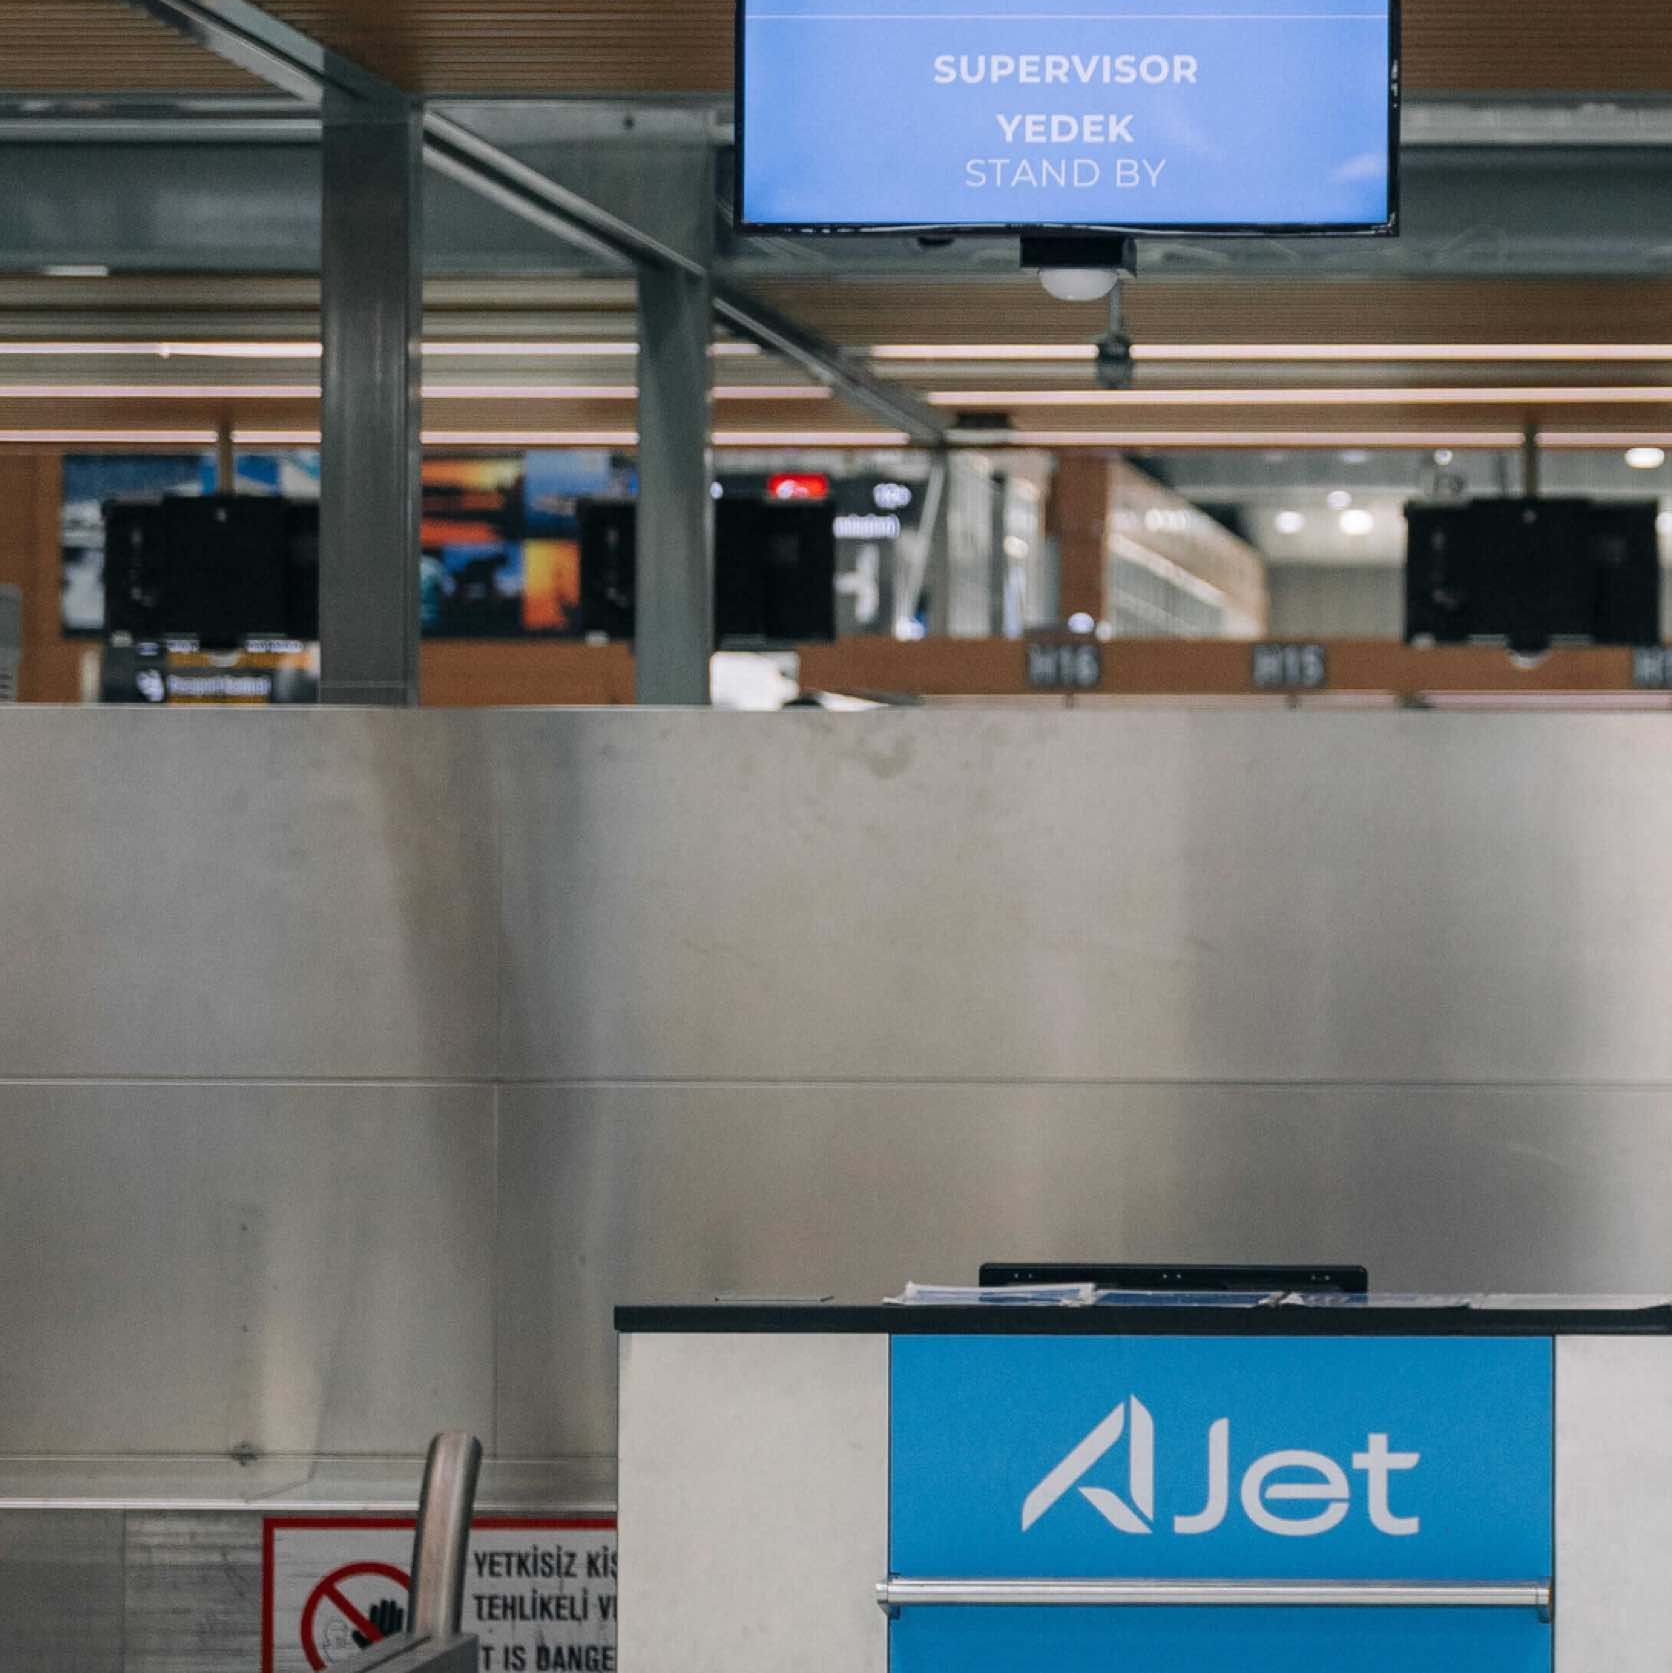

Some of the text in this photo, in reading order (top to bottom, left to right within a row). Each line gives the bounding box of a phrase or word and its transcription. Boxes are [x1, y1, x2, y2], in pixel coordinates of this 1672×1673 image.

[932, 54, 1199, 85] SUPERVISOR
[995, 113, 1135, 144] YEDEK
[964, 158, 1167, 189] STAND BY
[1020, 1392, 1421, 1537] AJet
[473, 1543, 577, 1579] YETKİSİZ
[473, 1588, 617, 1623] TEHLİKELİ V
[503, 1644, 527, 1672] IS
